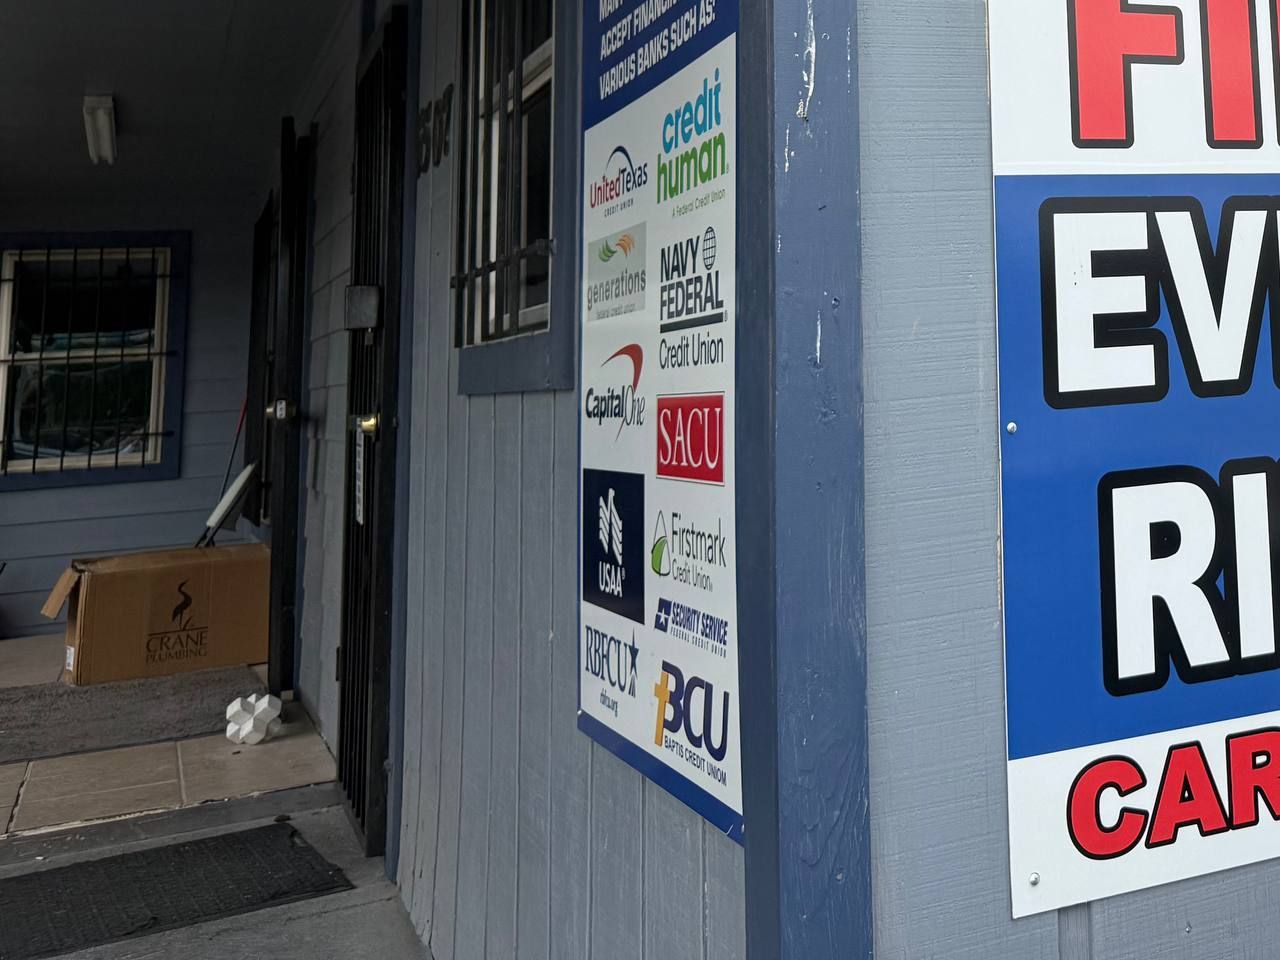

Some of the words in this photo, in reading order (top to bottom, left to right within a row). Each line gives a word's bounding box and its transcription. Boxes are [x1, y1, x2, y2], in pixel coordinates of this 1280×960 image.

[599, 54, 636, 101] VARIOUS
[637, 27, 669, 77] BANKS
[670, 5, 697, 53] SUCH
[600, 16, 632, 62] ACCEPT
[662, 67, 721, 155] credit
[656, 131, 727, 205] human
[660, 235, 700, 283] NAVY
[587, 266, 647, 311] generations
[659, 269, 724, 321] FEDERAL
[659, 334, 690, 370] Credit
[691, 330, 724, 367] Union
[659, 406, 722, 470] SACU
[671, 511, 727, 568] Firstmark
[598, 560, 624, 598] USAA
[671, 558, 691, 586] Credit
[691, 565, 711, 591] Union
[146, 630, 208, 653] CRANE
[671, 601, 701, 634] SECURITY
[700, 612, 728, 646] SERVICE
[585, 624, 627, 692] RBFCU
[684, 747, 706, 772] CREDIT
